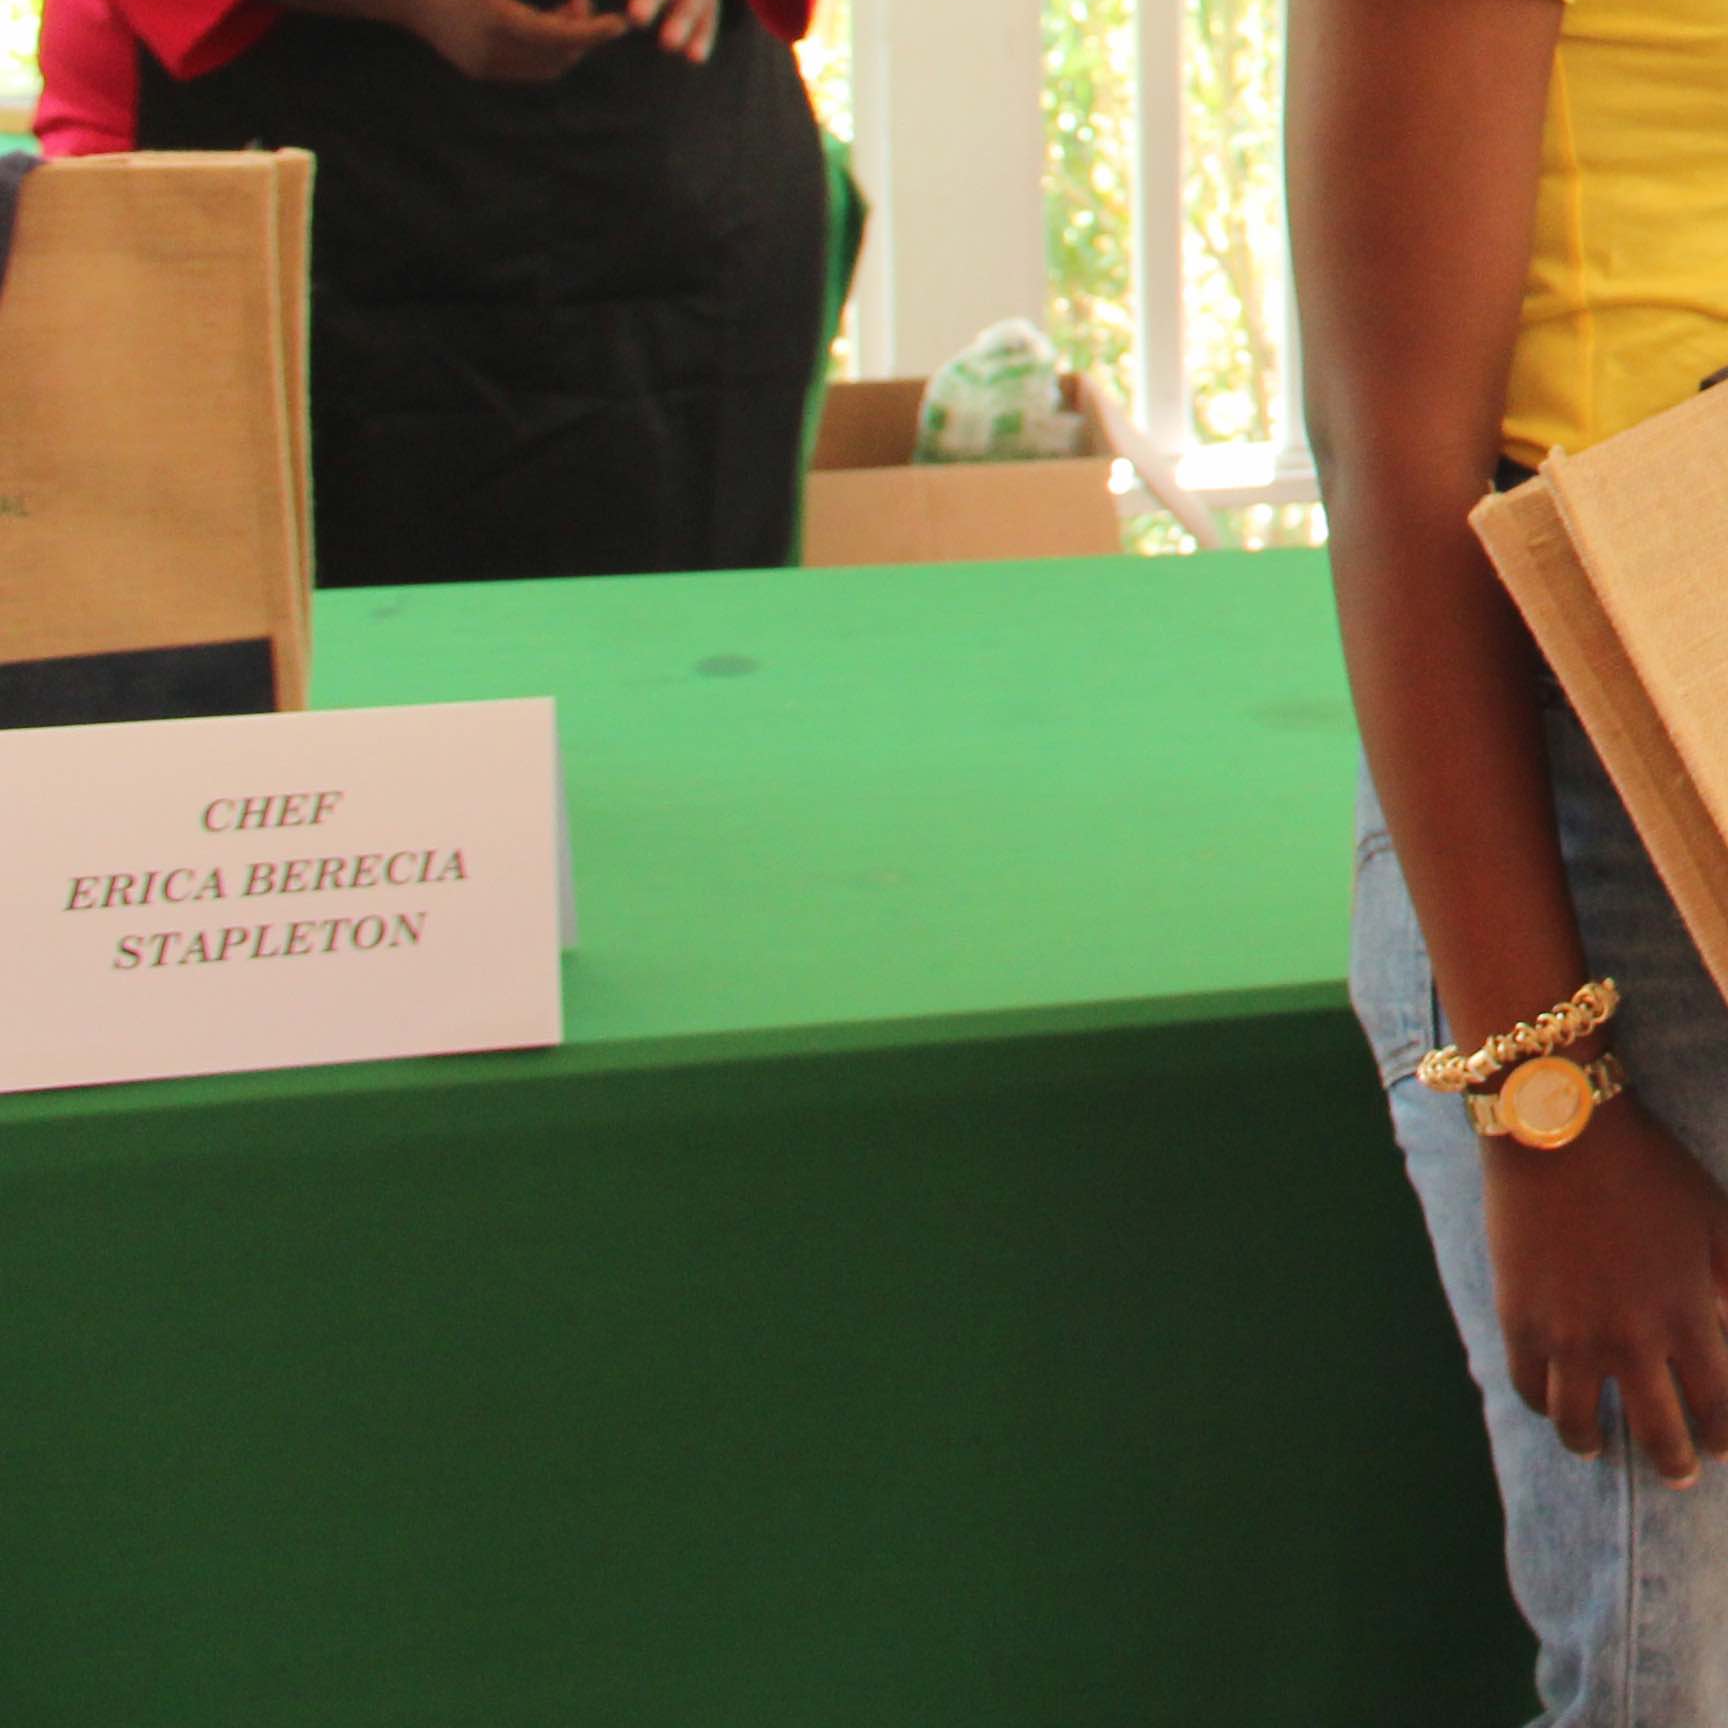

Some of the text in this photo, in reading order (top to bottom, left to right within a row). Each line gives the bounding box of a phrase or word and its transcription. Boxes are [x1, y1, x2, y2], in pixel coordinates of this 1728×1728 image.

[201, 789, 345, 833] CHEF
[63, 848, 471, 912] ERICA BERECIA
[111, 910, 428, 972] STAPLETON
